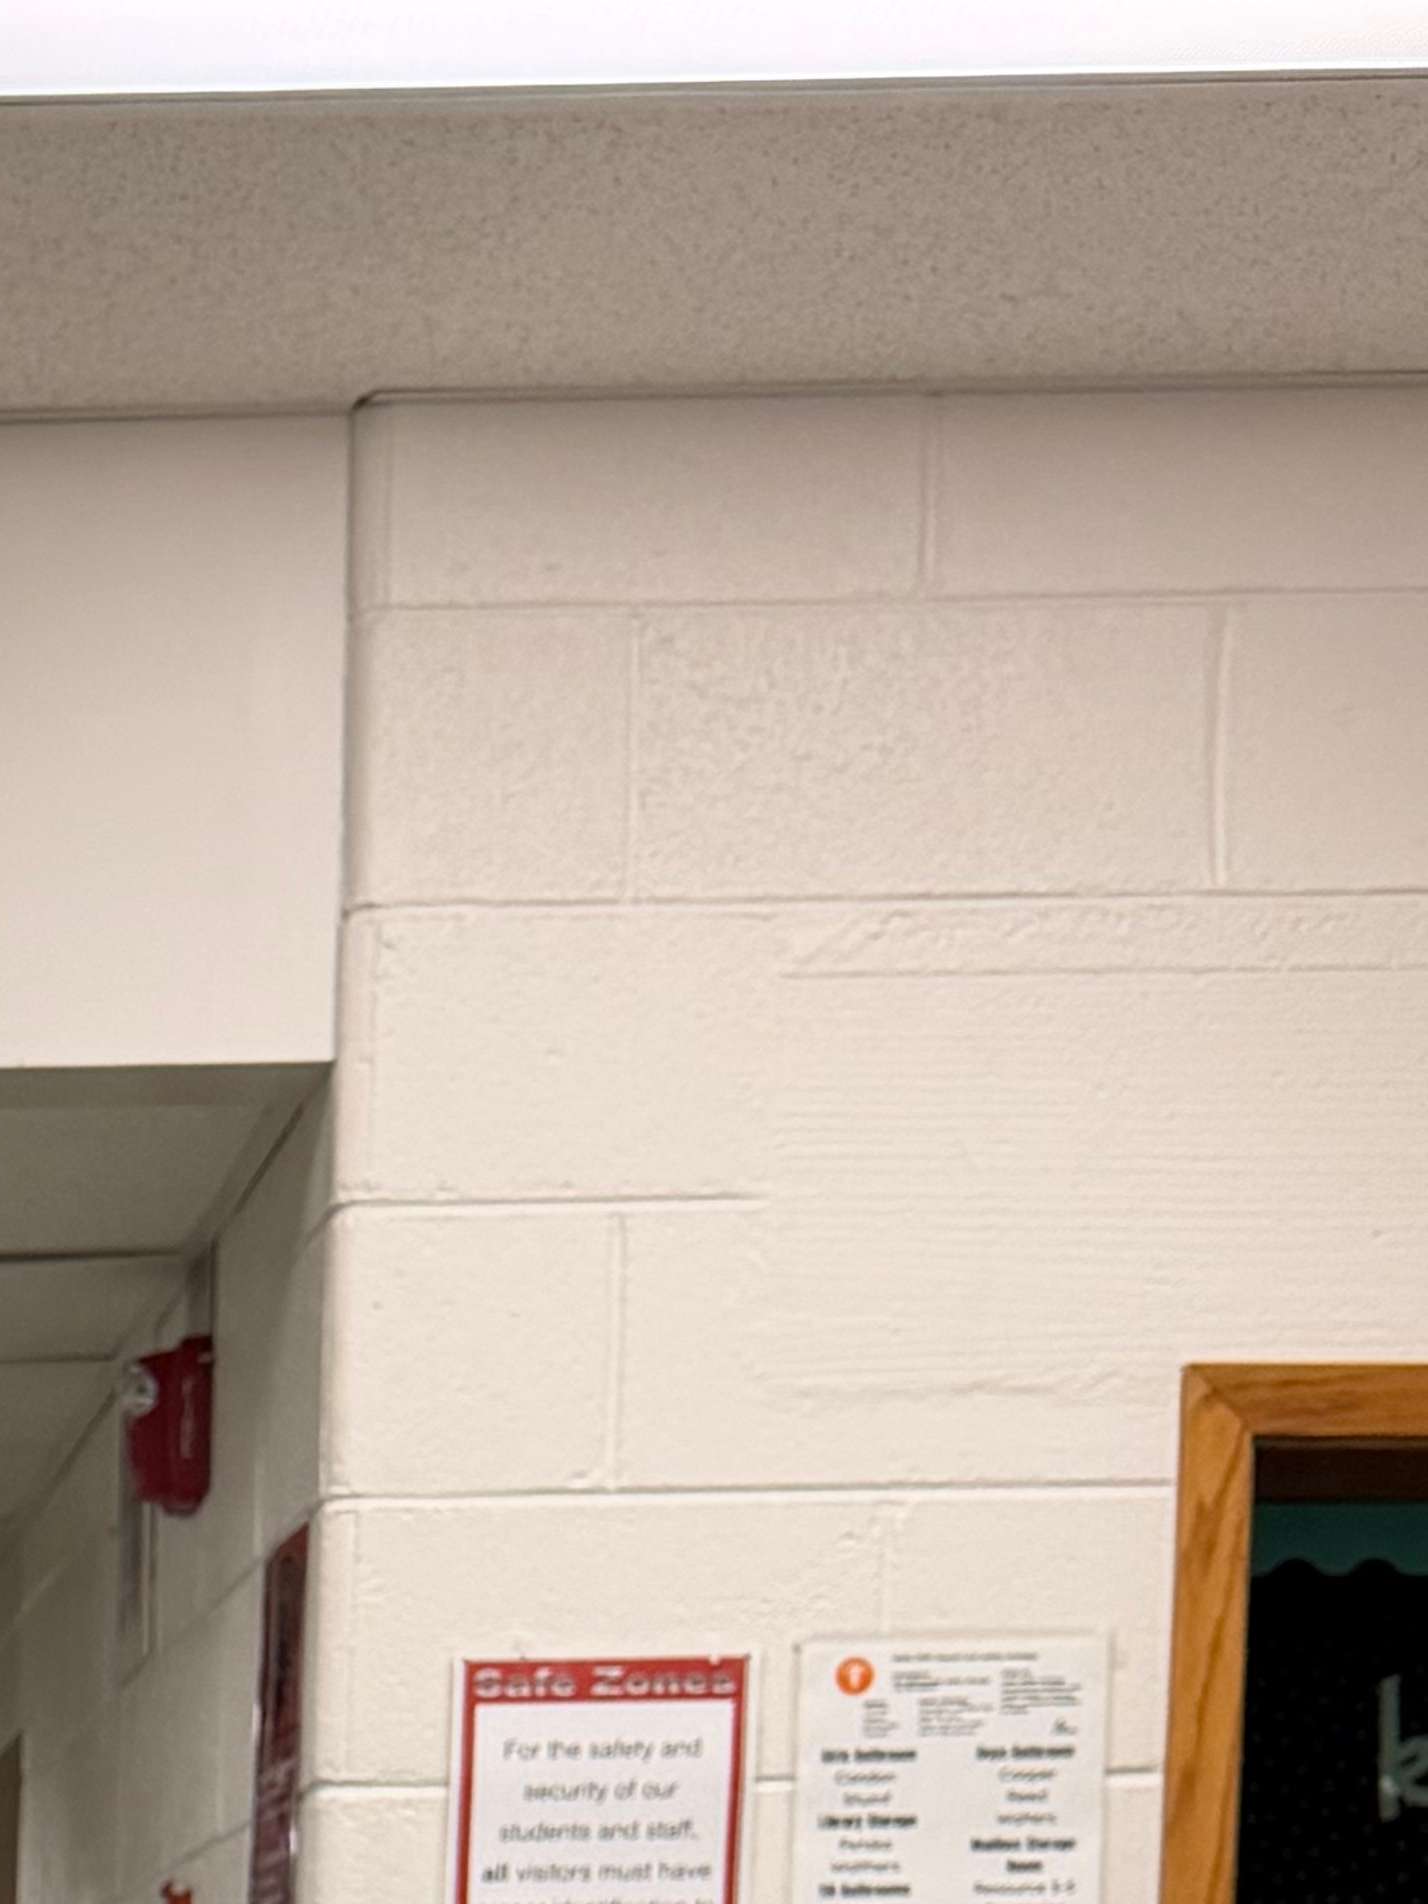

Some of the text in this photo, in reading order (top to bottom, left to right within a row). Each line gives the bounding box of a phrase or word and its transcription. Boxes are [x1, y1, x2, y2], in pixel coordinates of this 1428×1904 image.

[474, 1665, 736, 1698] Safe Zones
[502, 1737, 703, 1763] For the safety and
[523, 1781, 679, 1805] security of our
[499, 1824, 591, 1842] students
[598, 1823, 639, 1841] and
[481, 1862, 711, 1882] all visitors must have
